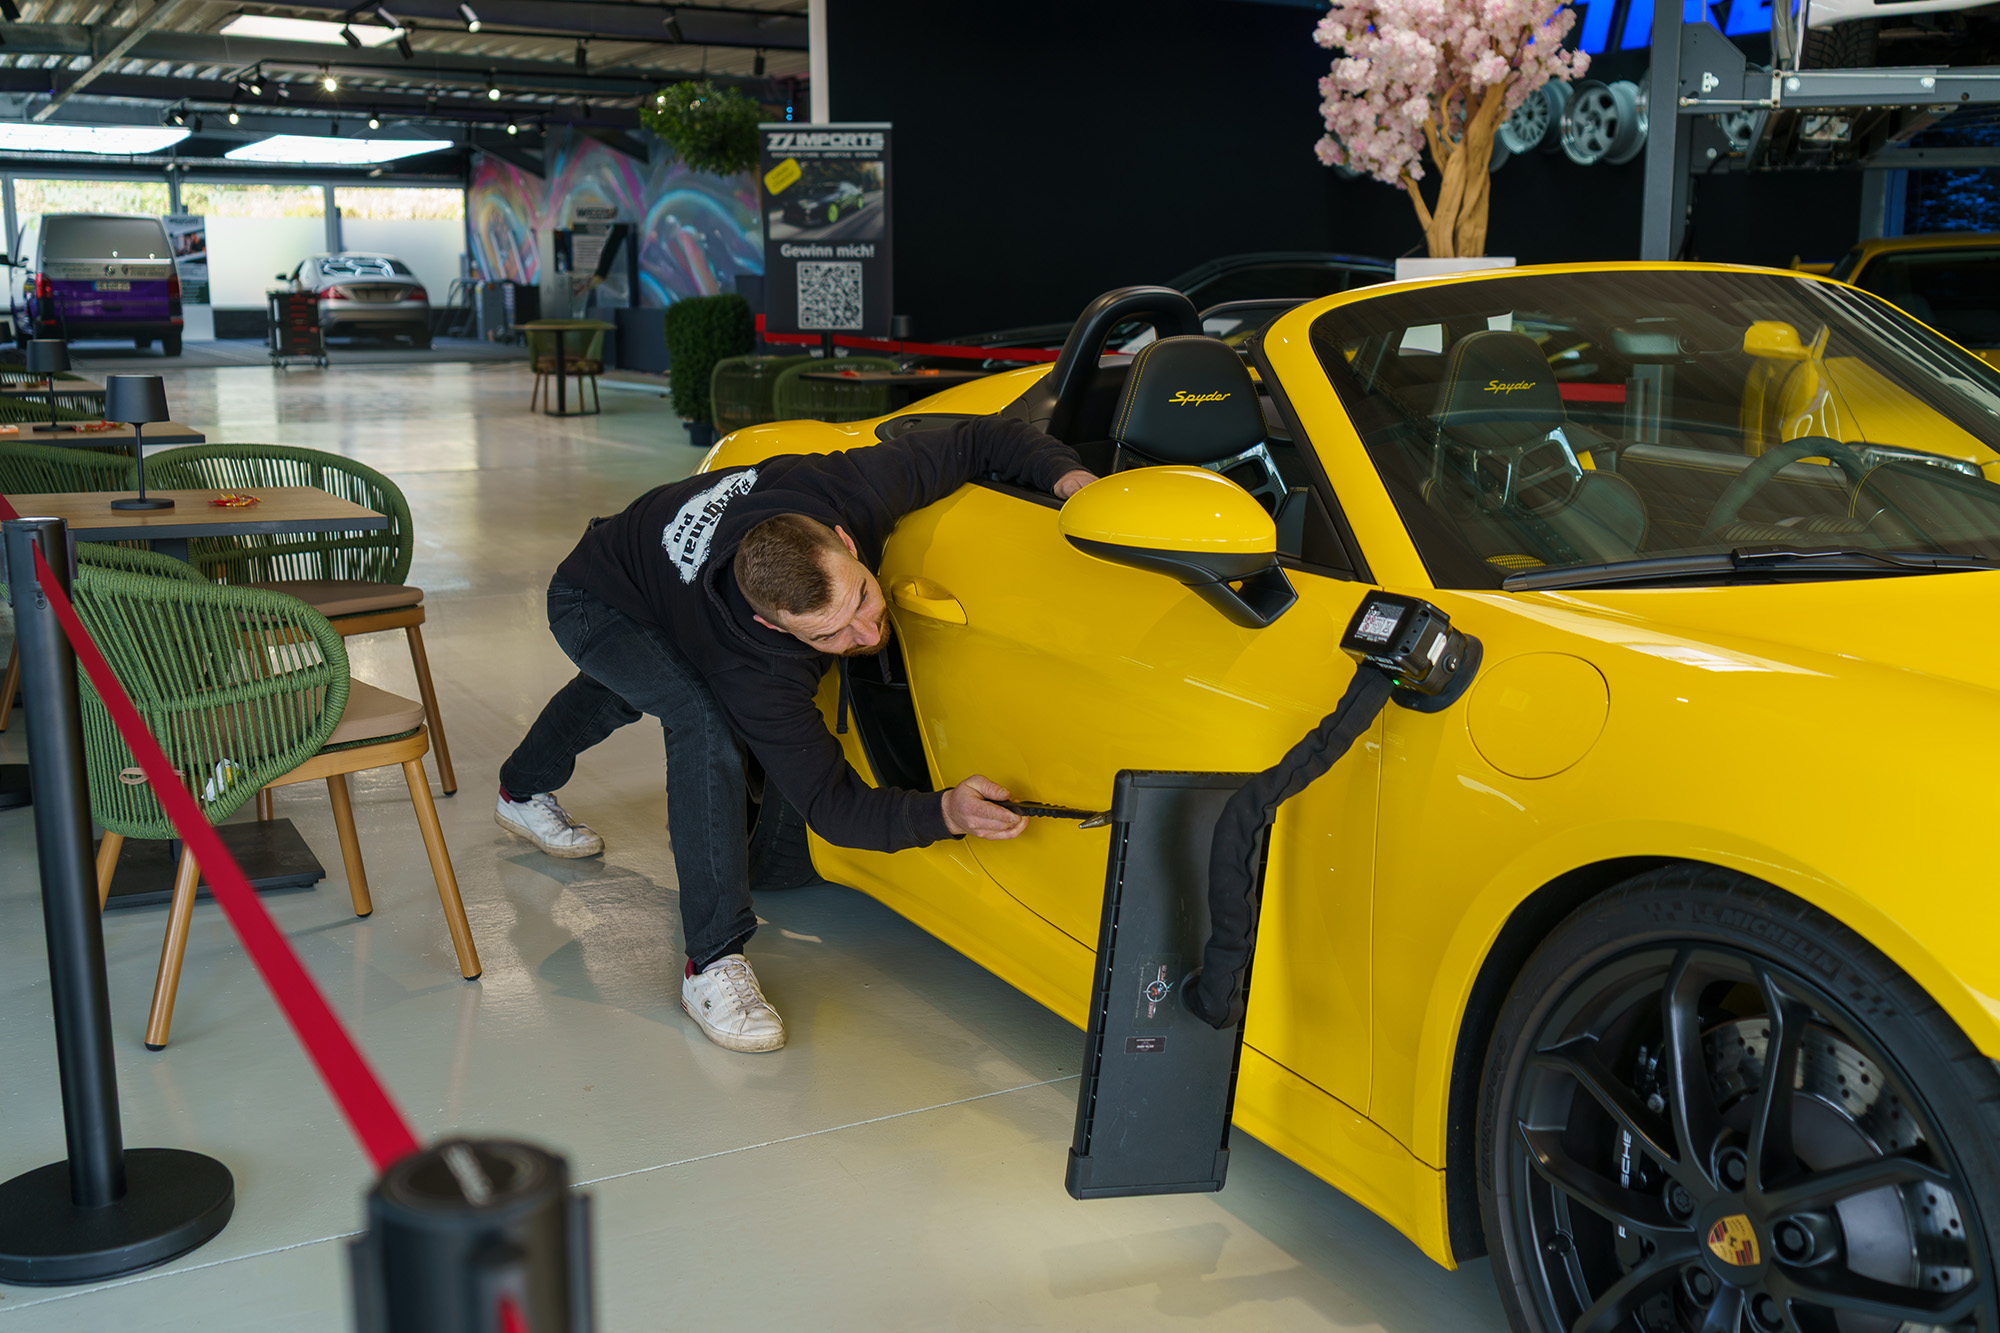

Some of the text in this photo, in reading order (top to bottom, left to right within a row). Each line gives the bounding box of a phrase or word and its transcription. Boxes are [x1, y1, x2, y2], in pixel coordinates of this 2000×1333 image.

[780, 243, 875, 258] Gewinn mich!
[1483, 379, 1536, 395] Spyder
[1168, 390, 1231, 407] Spyder
[1719, 907, 1840, 975] MICHELIN
